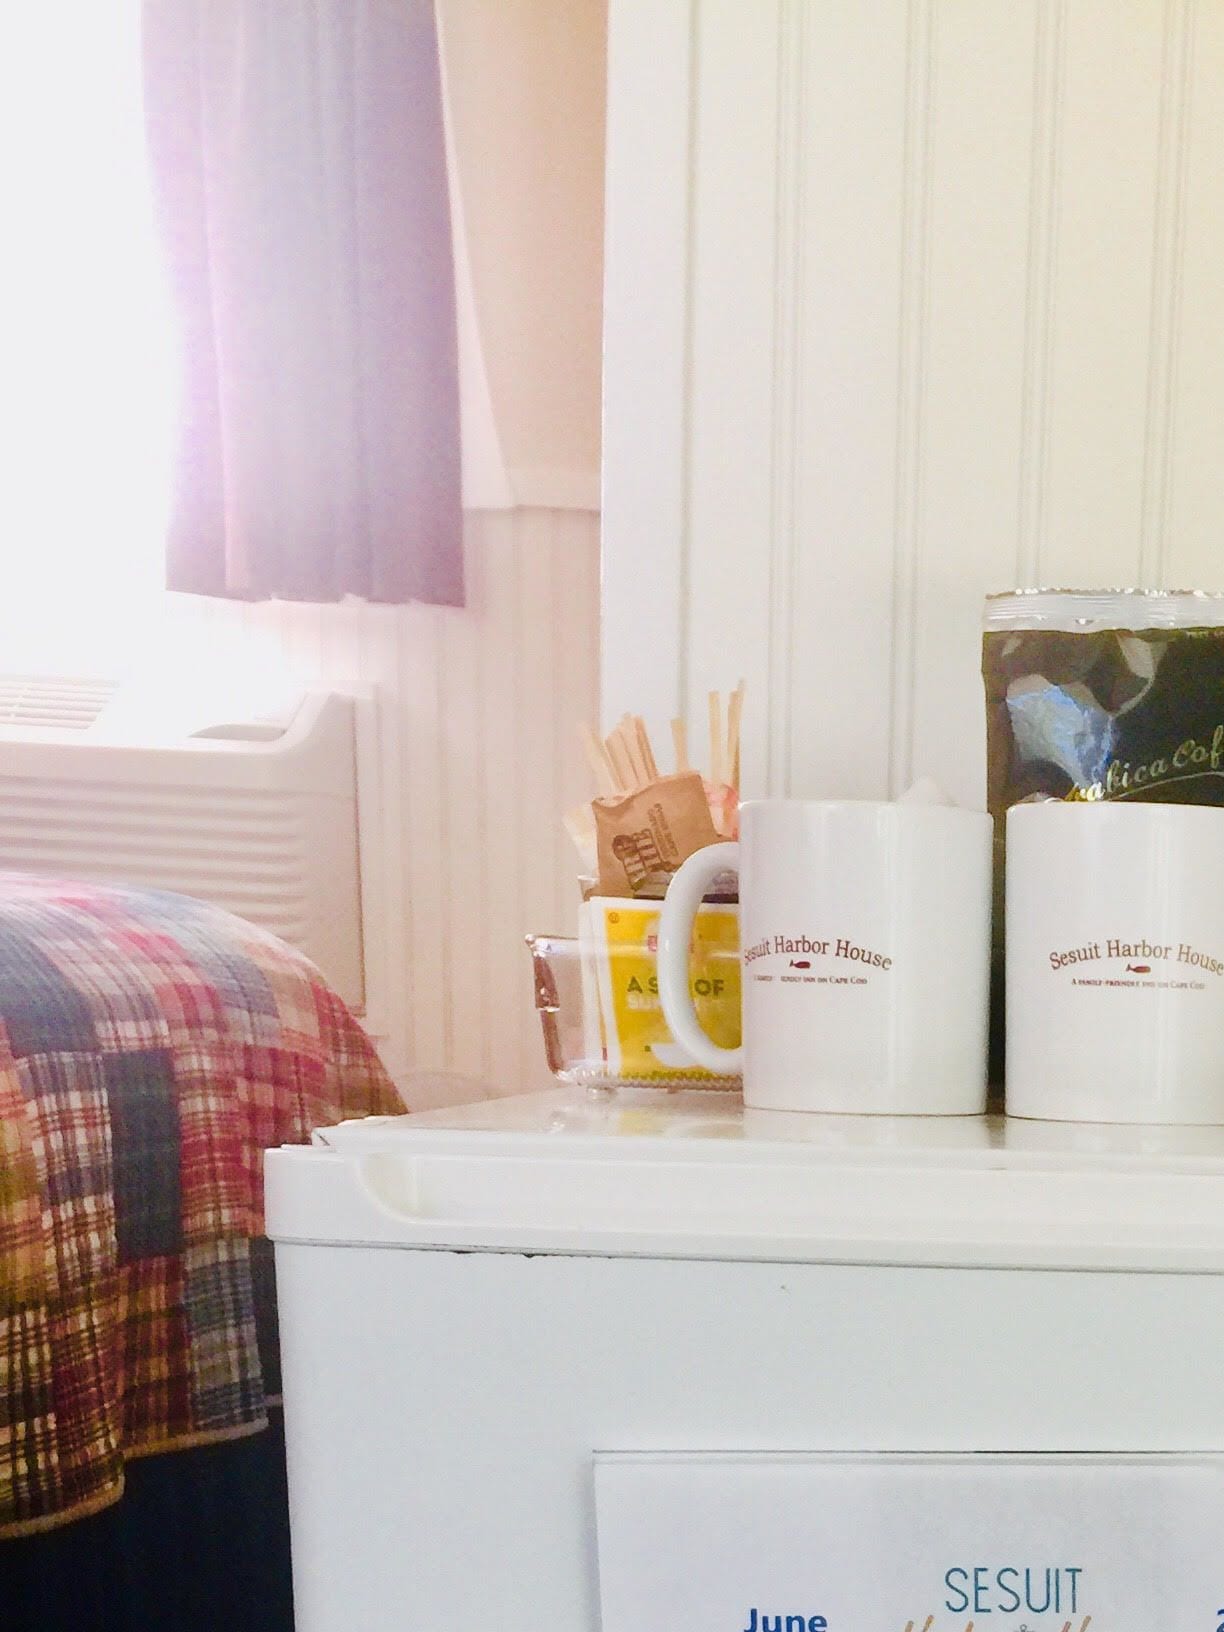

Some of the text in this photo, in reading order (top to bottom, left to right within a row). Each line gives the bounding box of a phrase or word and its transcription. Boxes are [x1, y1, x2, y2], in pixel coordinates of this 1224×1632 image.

[774, 935, 830, 954] Harbor
[835, 939, 893, 971] House
[1049, 939, 1224, 976] Sesuit Harbor House
[694, 978, 725, 998] OF
[944, 1567, 1083, 1613] SESUIT
